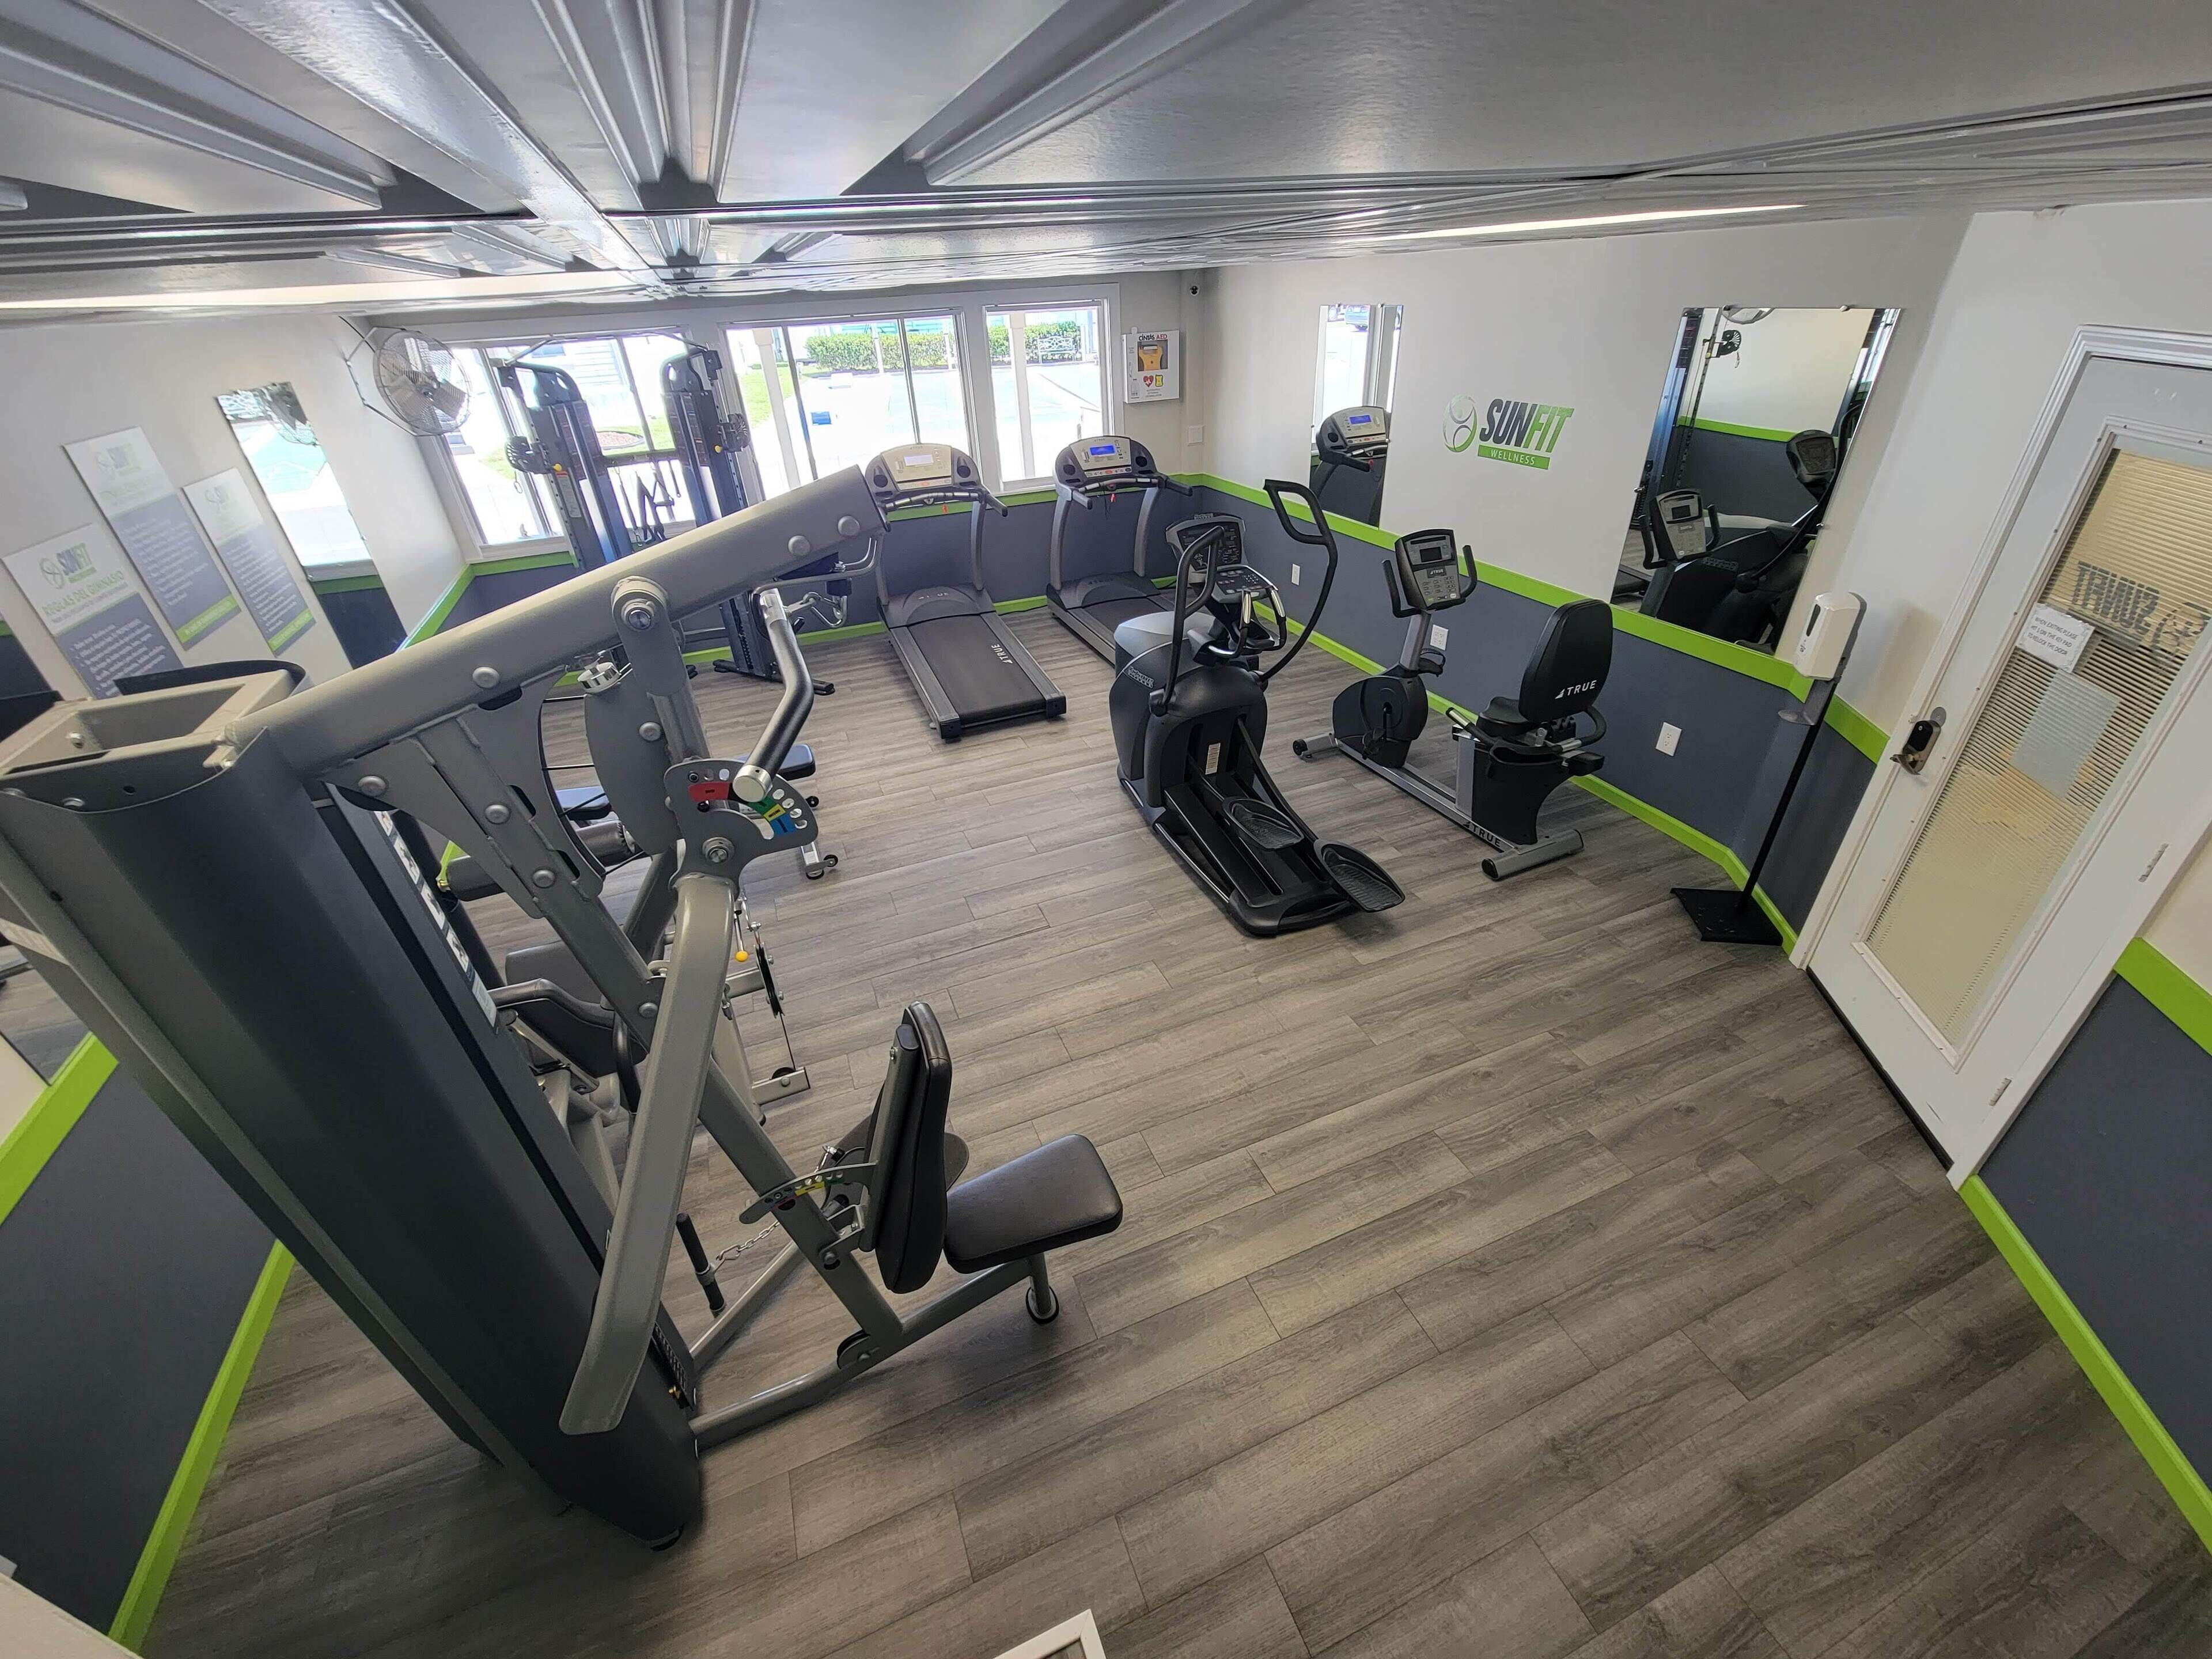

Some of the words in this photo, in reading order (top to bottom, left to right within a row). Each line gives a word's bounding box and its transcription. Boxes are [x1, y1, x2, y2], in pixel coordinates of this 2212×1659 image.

[1479, 398, 1575, 453] SUNFIT
[1491, 449, 1535, 465] WELLNESS
[991, 644, 1009, 660] TRUE
[1567, 680, 1597, 696] TRUE
[1472, 823, 1502, 847] TRUE
